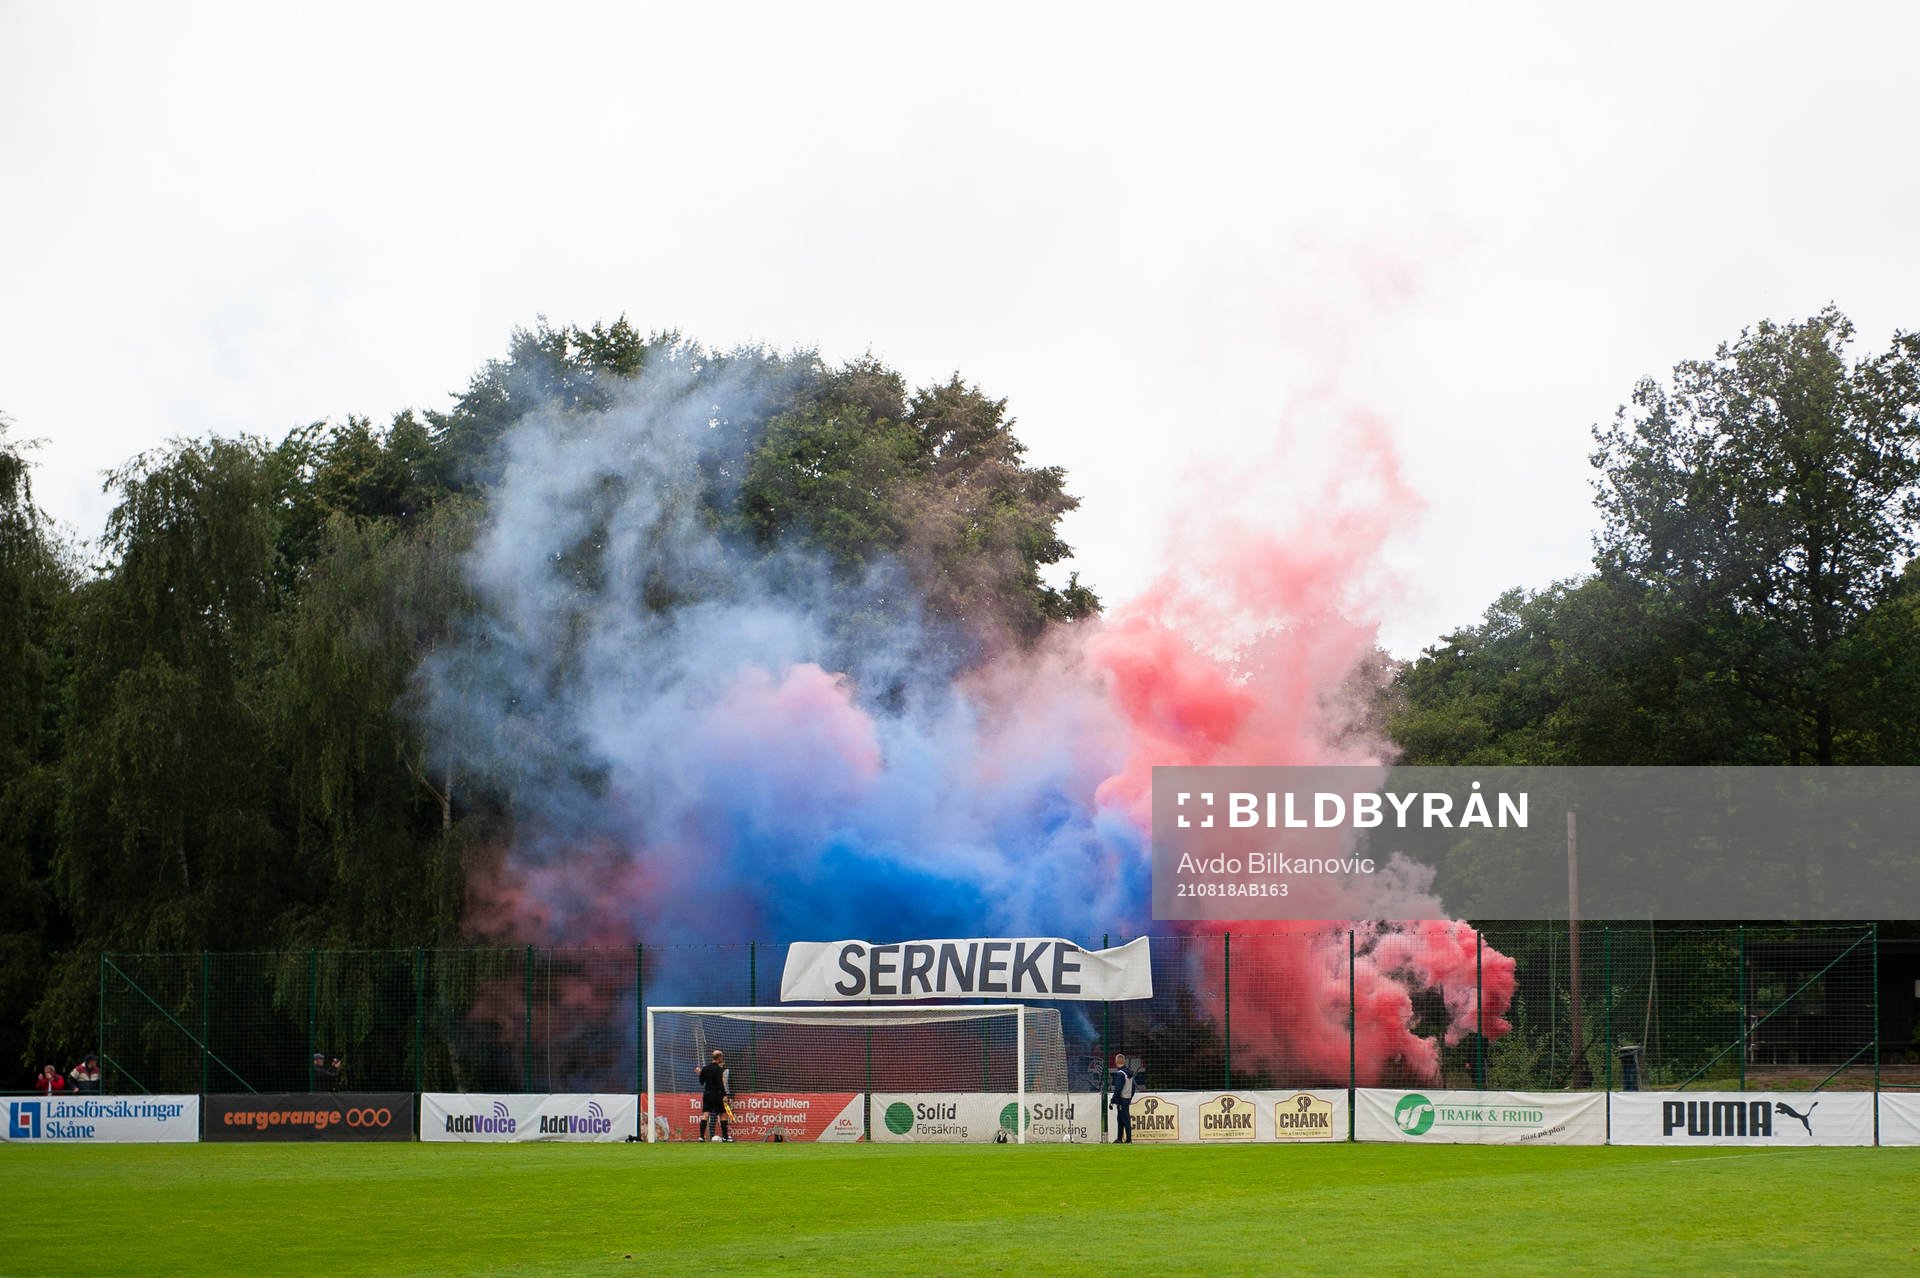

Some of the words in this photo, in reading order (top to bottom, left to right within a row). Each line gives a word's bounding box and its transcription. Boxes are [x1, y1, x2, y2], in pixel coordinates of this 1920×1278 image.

[835, 942, 1082, 996] SERNEKE
[46, 1100, 185, 1121] Länsförsäkringar
[748, 1098, 771, 1109] förbi
[773, 1098, 810, 1109] butiken
[916, 1103, 957, 1120] Solid
[1033, 1103, 1075, 1120] Solid
[224, 1110, 342, 1130] cargorange
[445, 1115, 517, 1133] AddVoice
[540, 1115, 611, 1133] AddVoice
[745, 1112, 760, 1123] för
[761, 1112, 782, 1125] god
[783, 1112, 807, 1123] mat!
[839, 1119, 852, 1127] ICA
[1203, 1114, 1252, 1129] CHARK
[1280, 1113, 1328, 1128] CHARK
[1440, 1109, 1483, 1121] TRAFIK
[1488, 1109, 1497, 1121] &
[1502, 1110, 1543, 1123] FRITID
[1663, 1101, 1772, 1136] PUMA
[46, 1121, 96, 1138] Skåne
[916, 1123, 968, 1137] Försäkring
[1033, 1124, 1087, 1138] Försäkring
